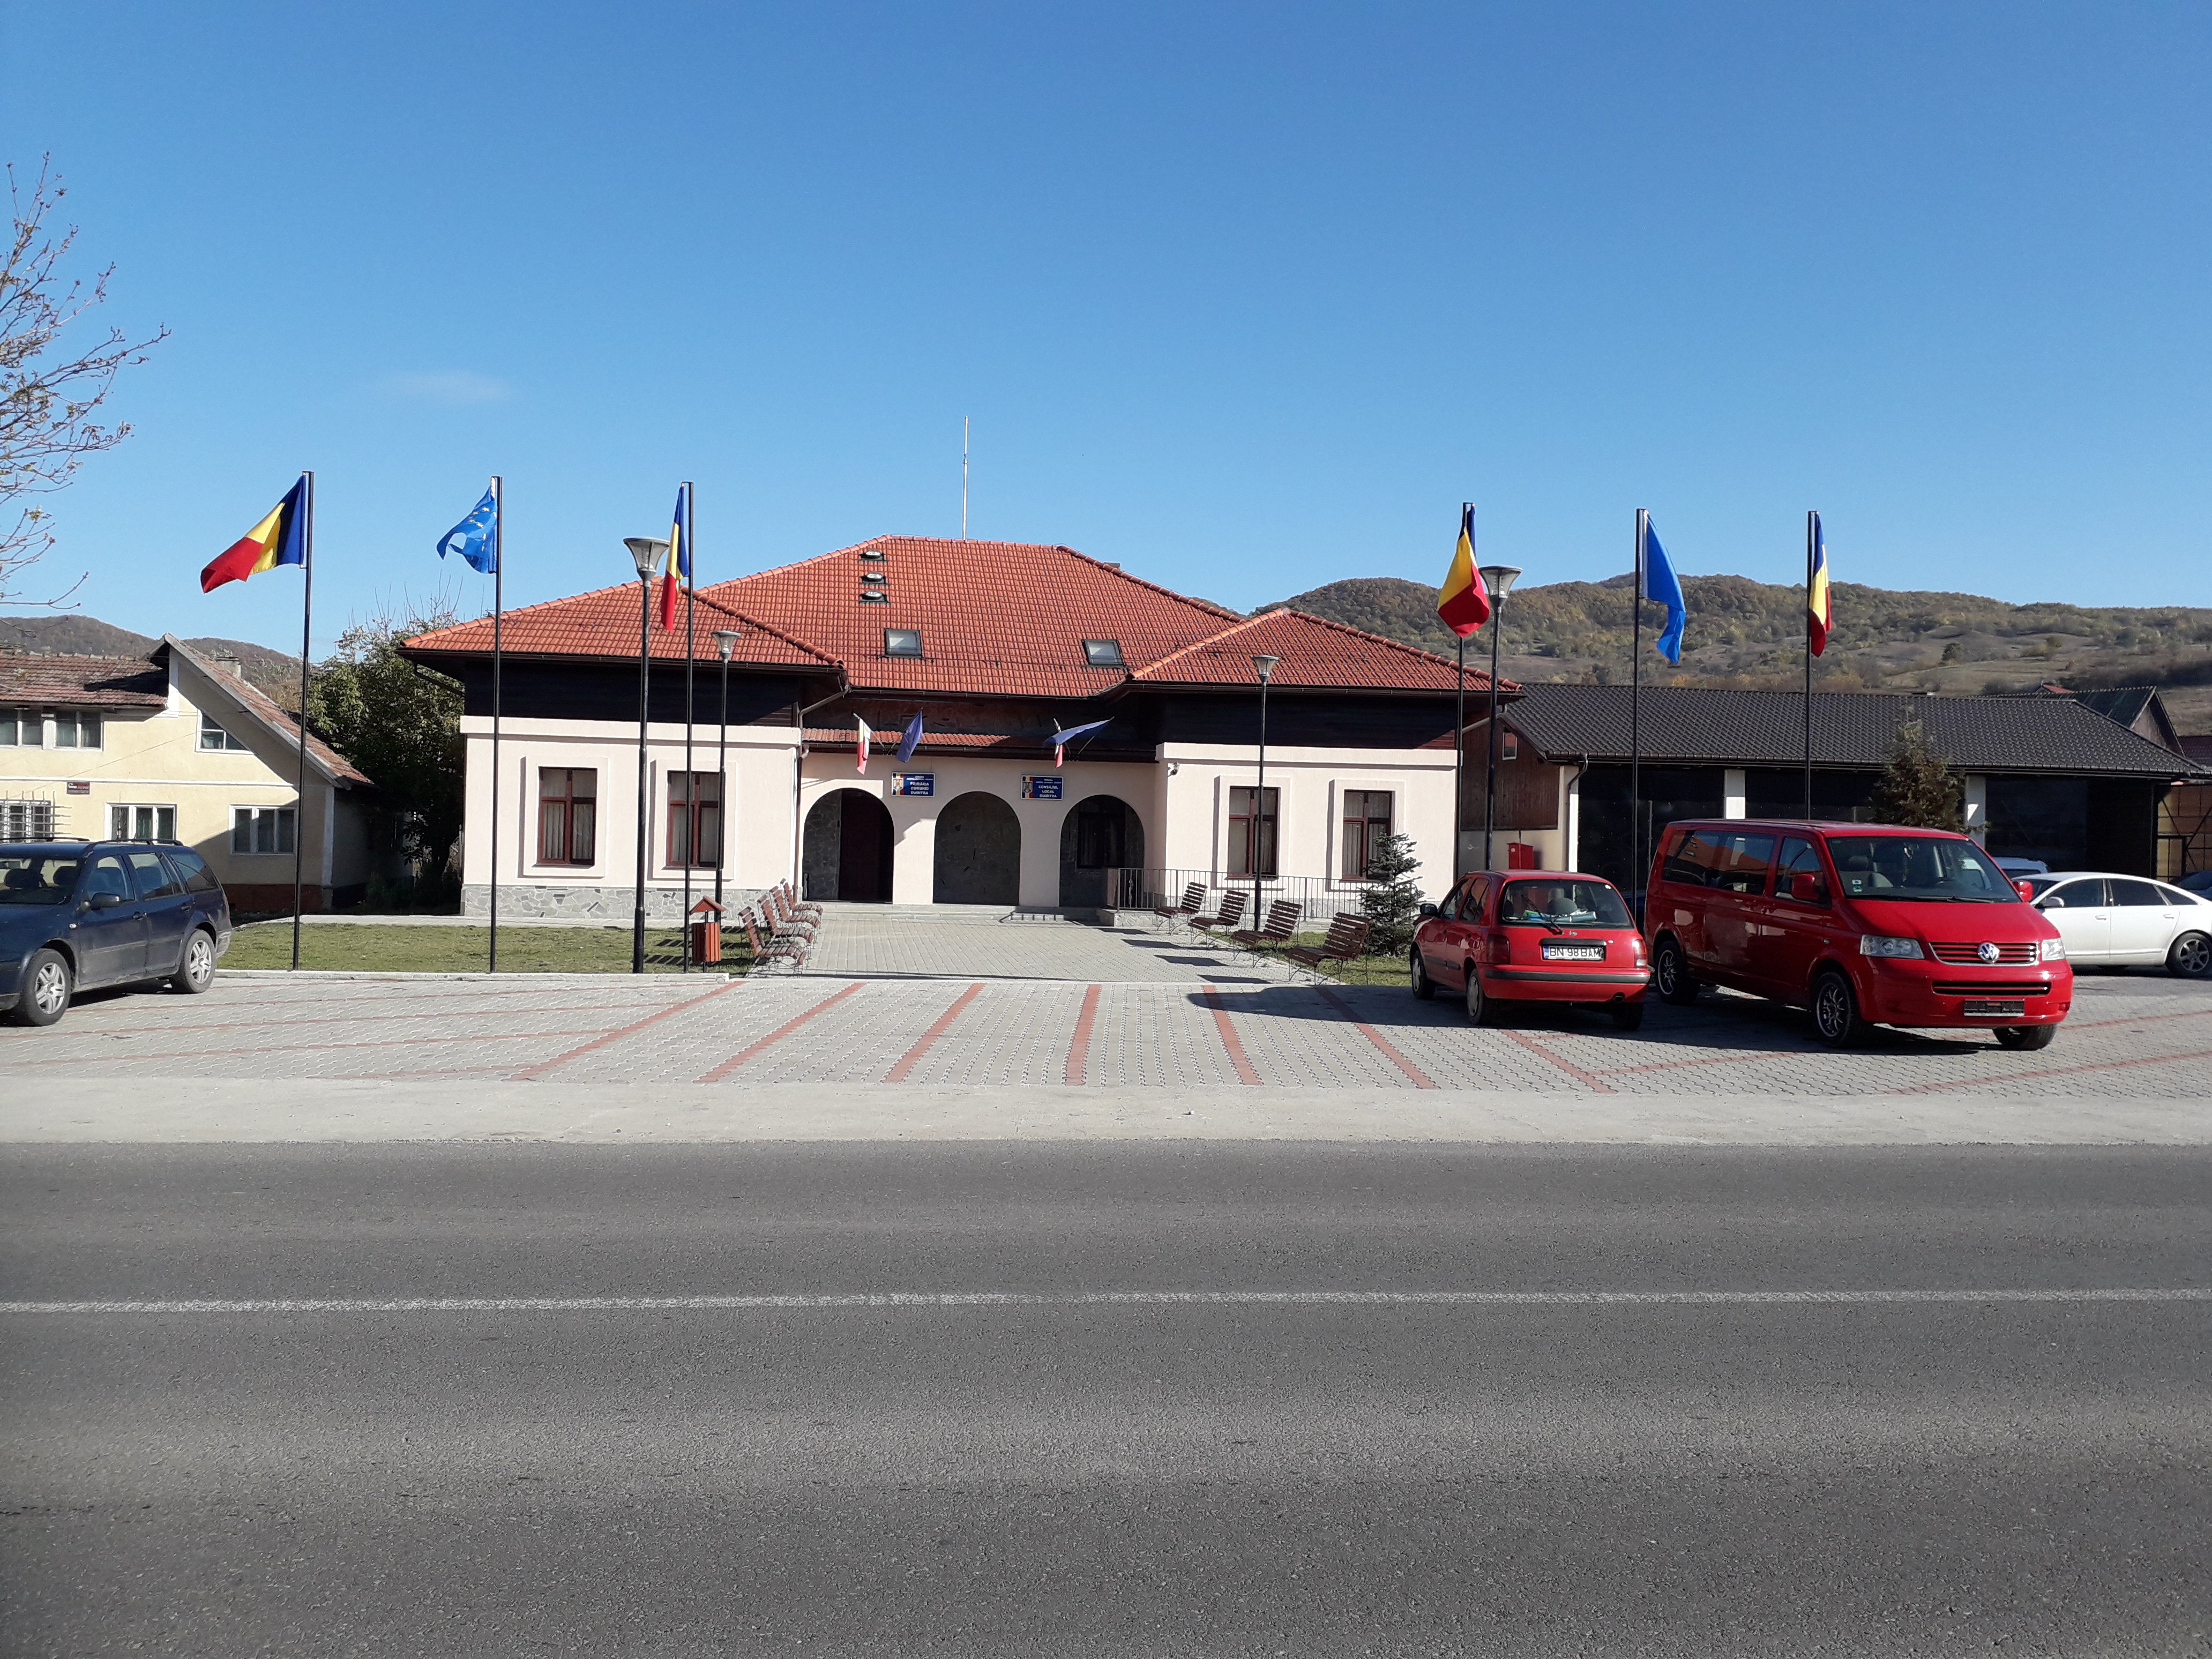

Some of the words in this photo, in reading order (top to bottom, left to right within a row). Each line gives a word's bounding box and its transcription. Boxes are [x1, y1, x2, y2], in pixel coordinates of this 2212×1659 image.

[1549, 947, 1564, 956] BN
[1567, 947, 1579, 957] 98
[1581, 948, 1600, 958] BAM
